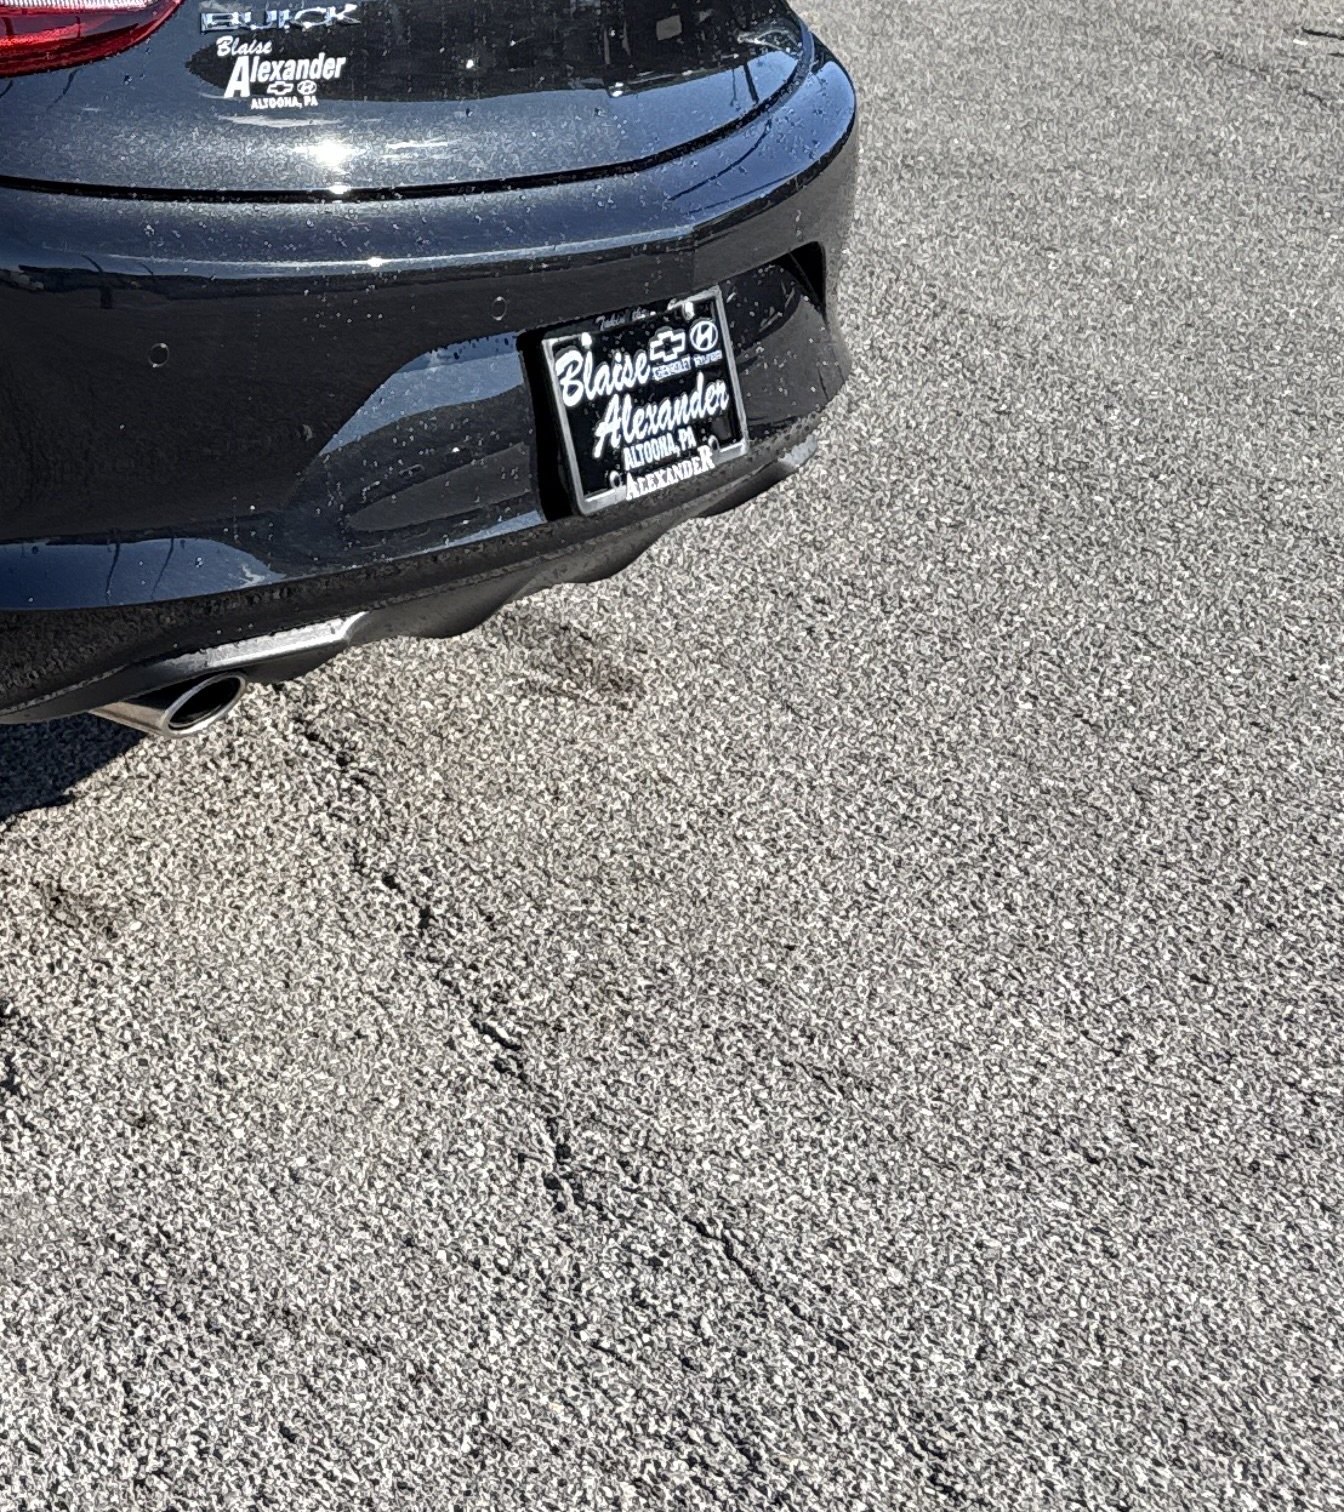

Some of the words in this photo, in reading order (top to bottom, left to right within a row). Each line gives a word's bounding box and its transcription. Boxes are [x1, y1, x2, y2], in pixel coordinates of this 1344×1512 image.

[199, 3, 362, 34] BUICK
[215, 35, 274, 58] Blaise
[223, 52, 348, 99] Alexander
[303, 95, 319, 107] PA
[555, 349, 651, 407] Blaise
[592, 371, 730, 459] Alexander
[623, 432, 681, 471] ALTOONA,
[677, 426, 697, 451] PA
[625, 444, 716, 501] ALEXANDER
